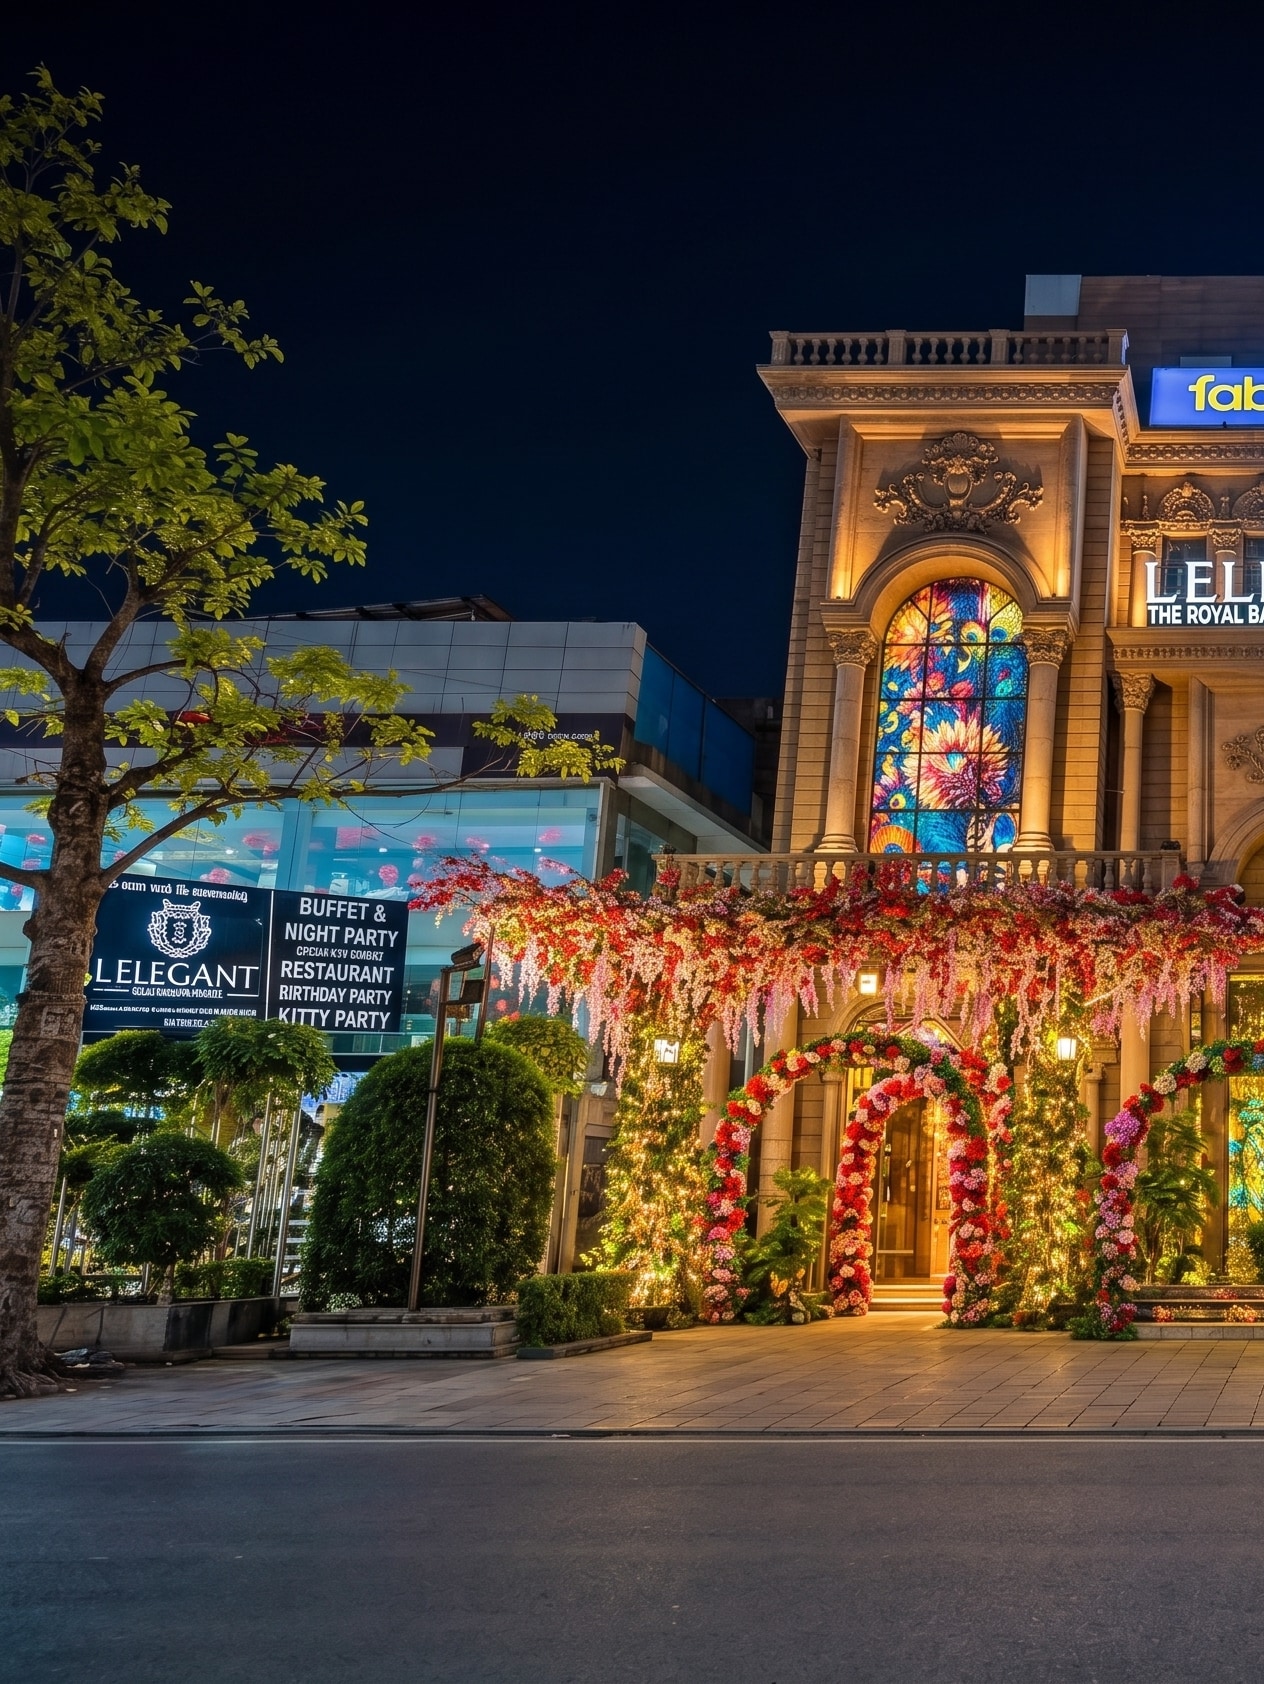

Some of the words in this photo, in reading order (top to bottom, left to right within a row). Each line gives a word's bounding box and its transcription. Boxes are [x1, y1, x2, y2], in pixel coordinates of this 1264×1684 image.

[1147, 604, 1182, 624] THE
[1187, 604, 1244, 624] ROYAL
[300, 896, 370, 920] BUFFET
[373, 904, 387, 922] &
[285, 922, 340, 943] NIGHT
[344, 926, 399, 948] PARTY
[95, 958, 259, 989] LELEGANT
[281, 960, 395, 984] RESTAURANT
[349, 988, 392, 1005] PARTY
[278, 1007, 331, 1027] KITTY
[334, 1009, 391, 1029] PARTY
